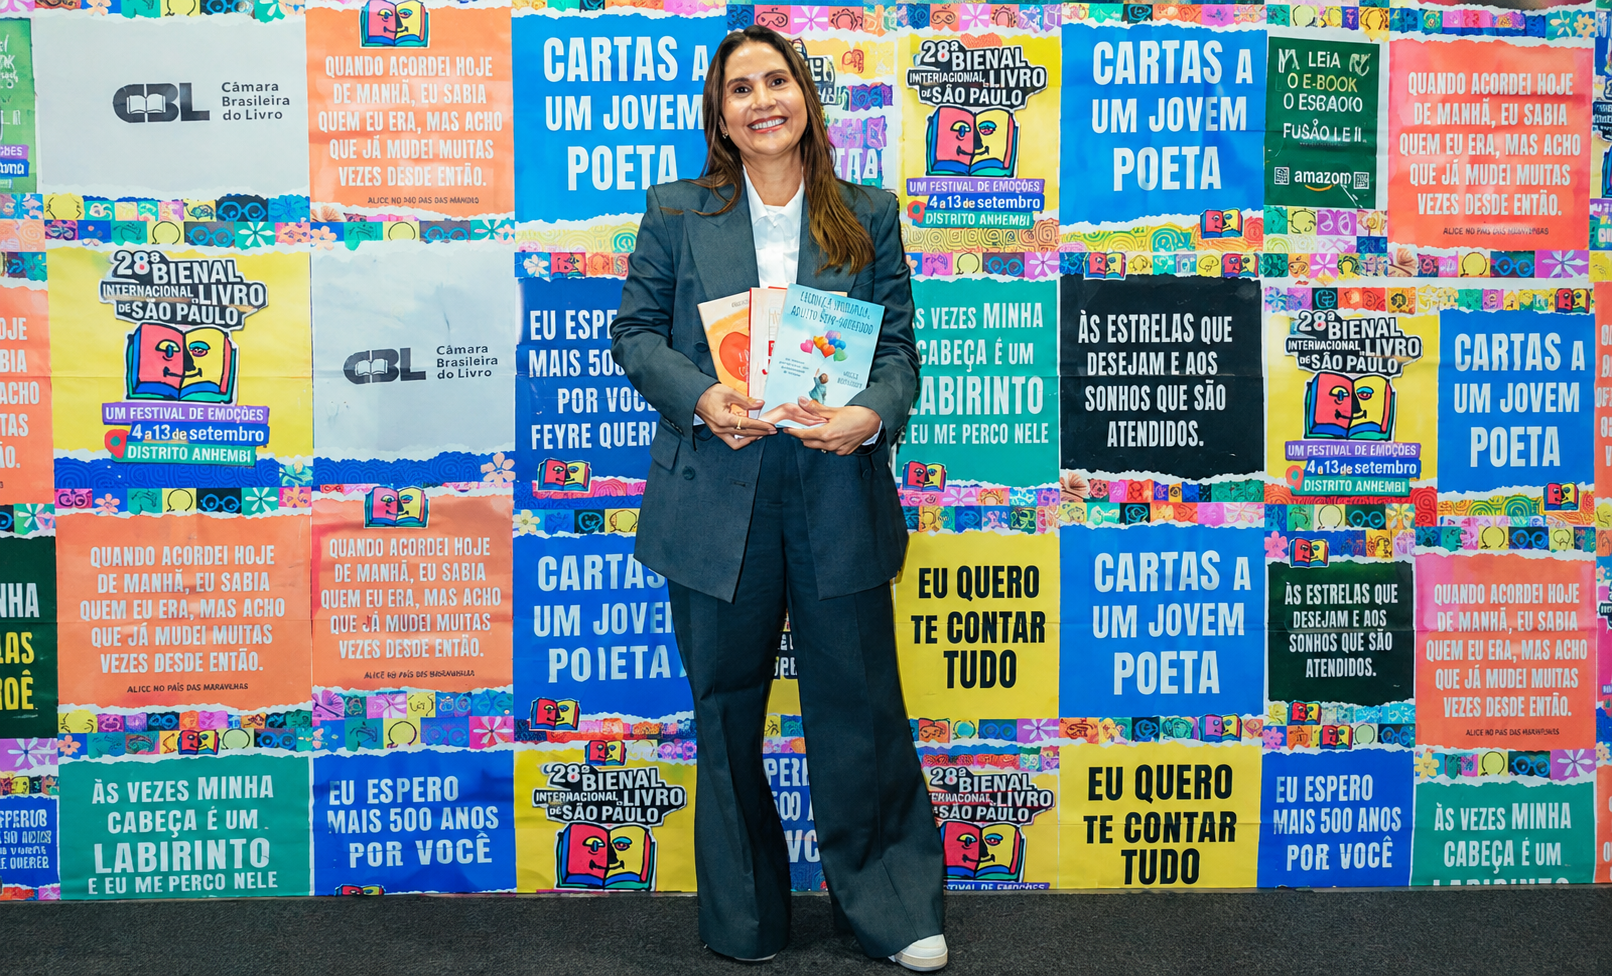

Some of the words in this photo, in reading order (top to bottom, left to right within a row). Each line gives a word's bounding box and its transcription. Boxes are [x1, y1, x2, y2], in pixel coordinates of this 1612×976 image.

[326, 56, 384, 78] QUANDO
[389, 56, 450, 77] ACORDEI
[457, 57, 492, 77] HOJE
[544, 36, 678, 82] CARTAS
[692, 45, 709, 81] A
[952, 48, 1025, 71] BIENAL
[1093, 40, 1222, 85] CARTAS
[1236, 49, 1252, 83] A
[990, 68, 1045, 88] LIVRO
[1287, 72, 1298, 89] O
[1303, 74, 1357, 92] E-BOOK
[1408, 72, 1466, 96] QUANDO
[1471, 73, 1531, 95] ACORDEI
[1537, 73, 1573, 95] HOJE
[113, 83, 210, 123] CBL
[222, 95, 289, 106] Brasileira
[932, 84, 965, 103] SÃO
[970, 88, 1022, 105] PAULO
[1283, 93, 1294, 109] O
[223, 110, 241, 120] do
[246, 109, 282, 120] Livro
[546, 96, 591, 131] UM
[604, 95, 704, 130] JOVEM
[1092, 99, 1137, 133] UM
[1149, 97, 1246, 132] JOVEM
[568, 145, 678, 190] POETA
[1114, 146, 1221, 191] POETA
[910, 181, 926, 192] UM
[930, 181, 974, 192] FESTIVAL
[978, 181, 990, 192] DE
[947, 195, 961, 208] 13
[977, 196, 1040, 208] setembro
[1418, 193, 1459, 215] VEZES
[1465, 193, 1508, 215] DESDE
[1514, 190, 1562, 215] ENTÃO.
[926, 213, 975, 225] DISTRITO
[152, 262, 241, 284] BIENAL
[103, 284, 194, 297] INTERNACIONAL
[199, 285, 264, 305] LIVRO
[119, 303, 131, 312] DE
[176, 303, 238, 324] PAULO
[530, 310, 555, 340] EU
[931, 307, 976, 329] VEZES
[984, 303, 1043, 328] MINHA
[1078, 310, 1100, 343] ÀS
[1108, 313, 1194, 343] ESTRELAS
[1201, 316, 1232, 344] QUE
[1328, 318, 1401, 339] BIENAL
[995, 338, 1002, 364] É
[1009, 343, 1033, 364] UM
[1365, 338, 1420, 357] LIVRO
[1455, 333, 1561, 371] CARTAS
[1571, 341, 1585, 370] A
[343, 348, 426, 384] CBL
[437, 356, 497, 367] Brasileira
[437, 370, 454, 379] do
[458, 369, 491, 378] Livro
[529, 350, 580, 377] MAIS
[1088, 352, 1165, 375] DESEJAM
[1171, 352, 1179, 375] E
[1186, 352, 1217, 375] AOS
[1312, 352, 1342, 369] SÃO
[1347, 355, 1398, 373] PAULO
[558, 388, 597, 413] POR
[1085, 385, 1150, 411] SONHOS
[1157, 385, 1187, 412] QUE
[1194, 380, 1225, 410] SÃO
[1454, 383, 1490, 413] UM
[1500, 383, 1579, 412] JOVEM
[106, 407, 126, 419] UM
[130, 407, 185, 419] FESTIVAL
[189, 408, 204, 420] DE
[132, 424, 142, 439] 4
[145, 431, 152, 440] a
[153, 425, 170, 440] 13
[172, 428, 187, 440] de
[189, 426, 264, 441] setembro
[532, 423, 591, 449] FEYRE
[912, 424, 928, 444] EU
[935, 424, 956, 444] ME
[963, 424, 1008, 444] PERCO
[1015, 423, 1048, 443] NELE
[1108, 420, 1203, 447] ATENDIDOS.
[128, 446, 188, 460] DISTRITO
[1471, 427, 1560, 467] POETA
[1355, 460, 1417, 474] setembro
[1304, 480, 1352, 491] DISTRITO
[919, 568, 947, 598] EU
[957, 566, 1039, 601] QUERO
[1285, 582, 1301, 604] ÀS
[1307, 584, 1369, 604] ESTRELAS
[1375, 584, 1398, 605] QUE
[80, 600, 126, 621] QUEM
[133, 600, 152, 619] EU
[159, 599, 194, 621] ERA,
[201, 599, 236, 618] MAS
[243, 598, 285, 617] ACHO
[1093, 605, 1137, 638] UM
[1149, 603, 1244, 637] JOVEM
[92, 627, 121, 648] QUE
[128, 622, 148, 646] JÁ
[155, 626, 206, 645] MUDEI
[213, 624, 272, 644] MUITAS
[911, 615, 937, 644] TE
[947, 611, 1045, 644] CONTAR
[101, 653, 148, 673] VEZES
[155, 653, 203, 672] DESDE
[210, 648, 263, 671] ENTÃO.
[944, 650, 1016, 689] TUDO
[1114, 651, 1220, 695] POETA
[1306, 658, 1376, 677] ATENDIDOS.
[1436, 669, 1460, 690] QUE
[1465, 665, 1481, 688] JÁ
[1486, 668, 1526, 688] MUDEI
[1531, 668, 1578, 688] MUITAS
[92, 779, 118, 804] ÀS
[127, 780, 189, 802] VEZES
[198, 775, 273, 800] MINHA
[582, 769, 662, 791] BIENAL
[1135, 764, 1232, 804] QUERO
[1277, 777, 1297, 802] EU
[1305, 775, 1373, 802] ESPERO
[624, 788, 682, 806] LIVRO
[327, 809, 381, 833] MAIS
[390, 808, 431, 832] 500
[441, 806, 498, 830] ANOS
[602, 806, 658, 822] PAULO
[1461, 808, 1505, 830] VEZES
[1512, 803, 1571, 829] MINHA
[94, 838, 269, 873] LABIRINTO
[350, 842, 403, 868] POR
[416, 833, 492, 865] VOCÊ
[1121, 848, 1200, 885] TUDO
[89, 878, 97, 894] E
[105, 877, 126, 894] EU
[135, 876, 162, 893] ME
[169, 874, 225, 891] PERCO
[234, 871, 278, 889] NELE
